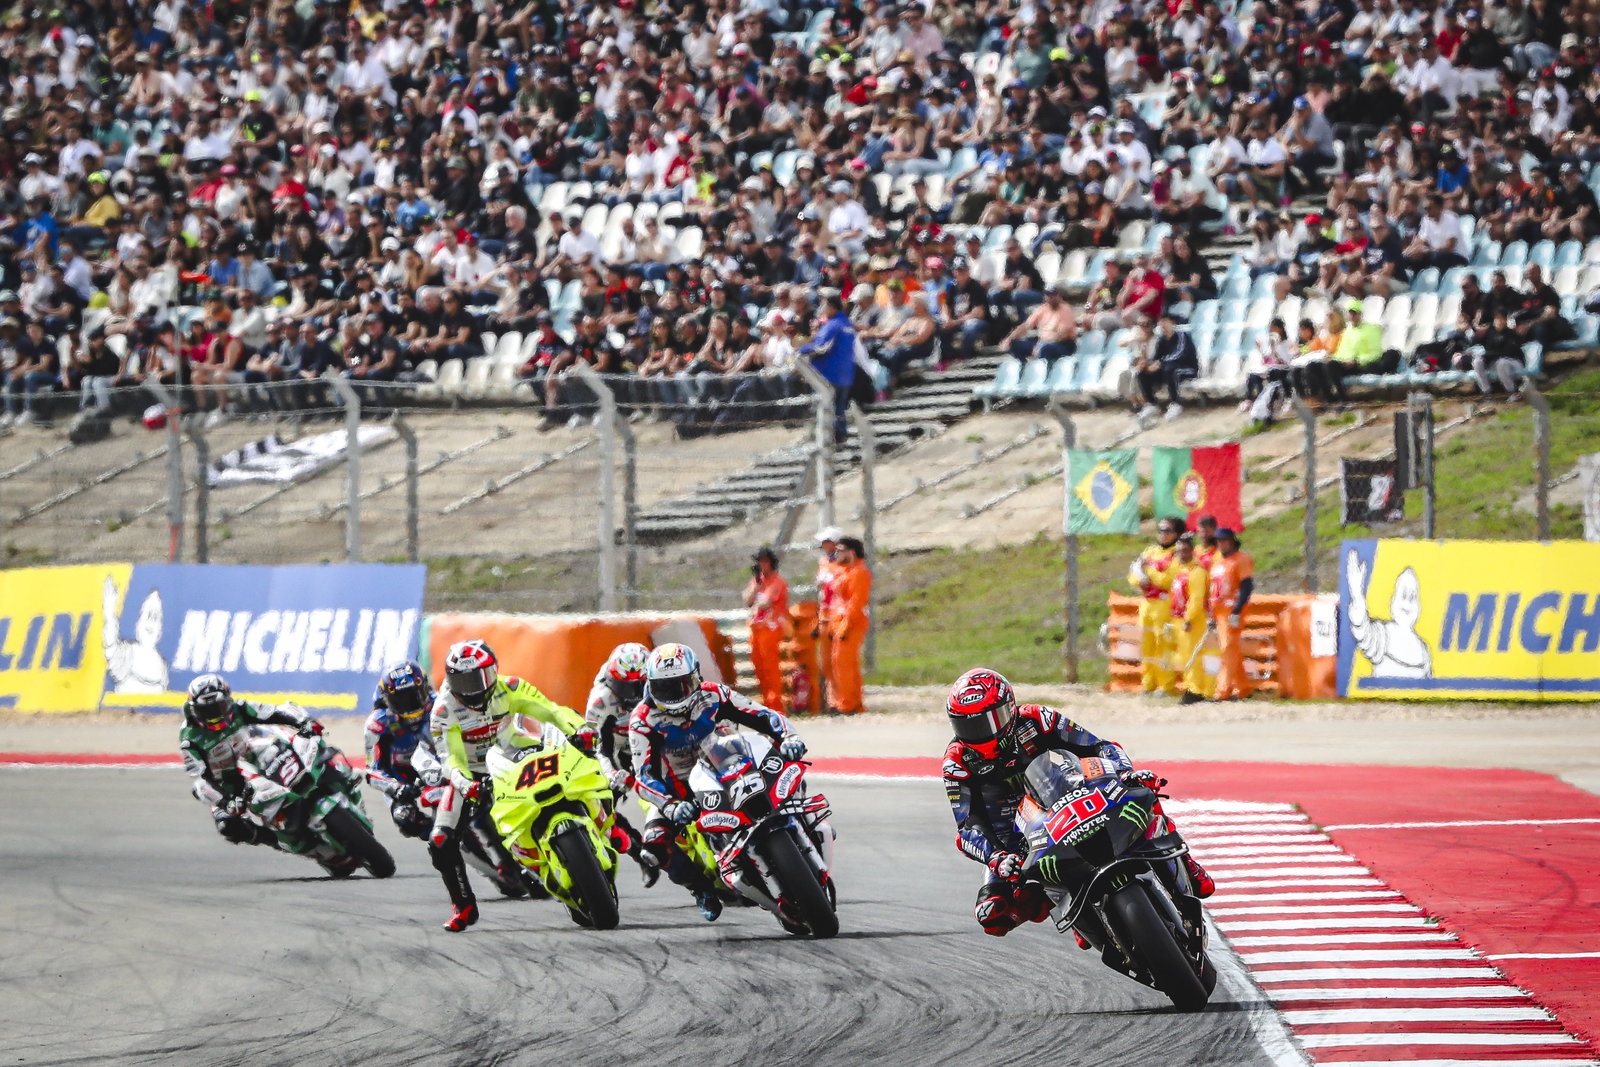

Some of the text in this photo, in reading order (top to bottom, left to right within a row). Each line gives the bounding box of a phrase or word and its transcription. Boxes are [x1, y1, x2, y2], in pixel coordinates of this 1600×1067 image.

[1440, 591, 1600, 653] MICH
[171, 609, 419, 674] MICHELIN
[515, 753, 560, 791] 49
[778, 764, 799, 798] sterilgarda
[730, 772, 765, 811] 25
[1052, 788, 1090, 811] ENEOS
[702, 812, 739, 827] sterilgarda
[1044, 788, 1109, 844] 20
[960, 837, 987, 863] YAMAHA
[1071, 822, 1106, 847] ENERGY
